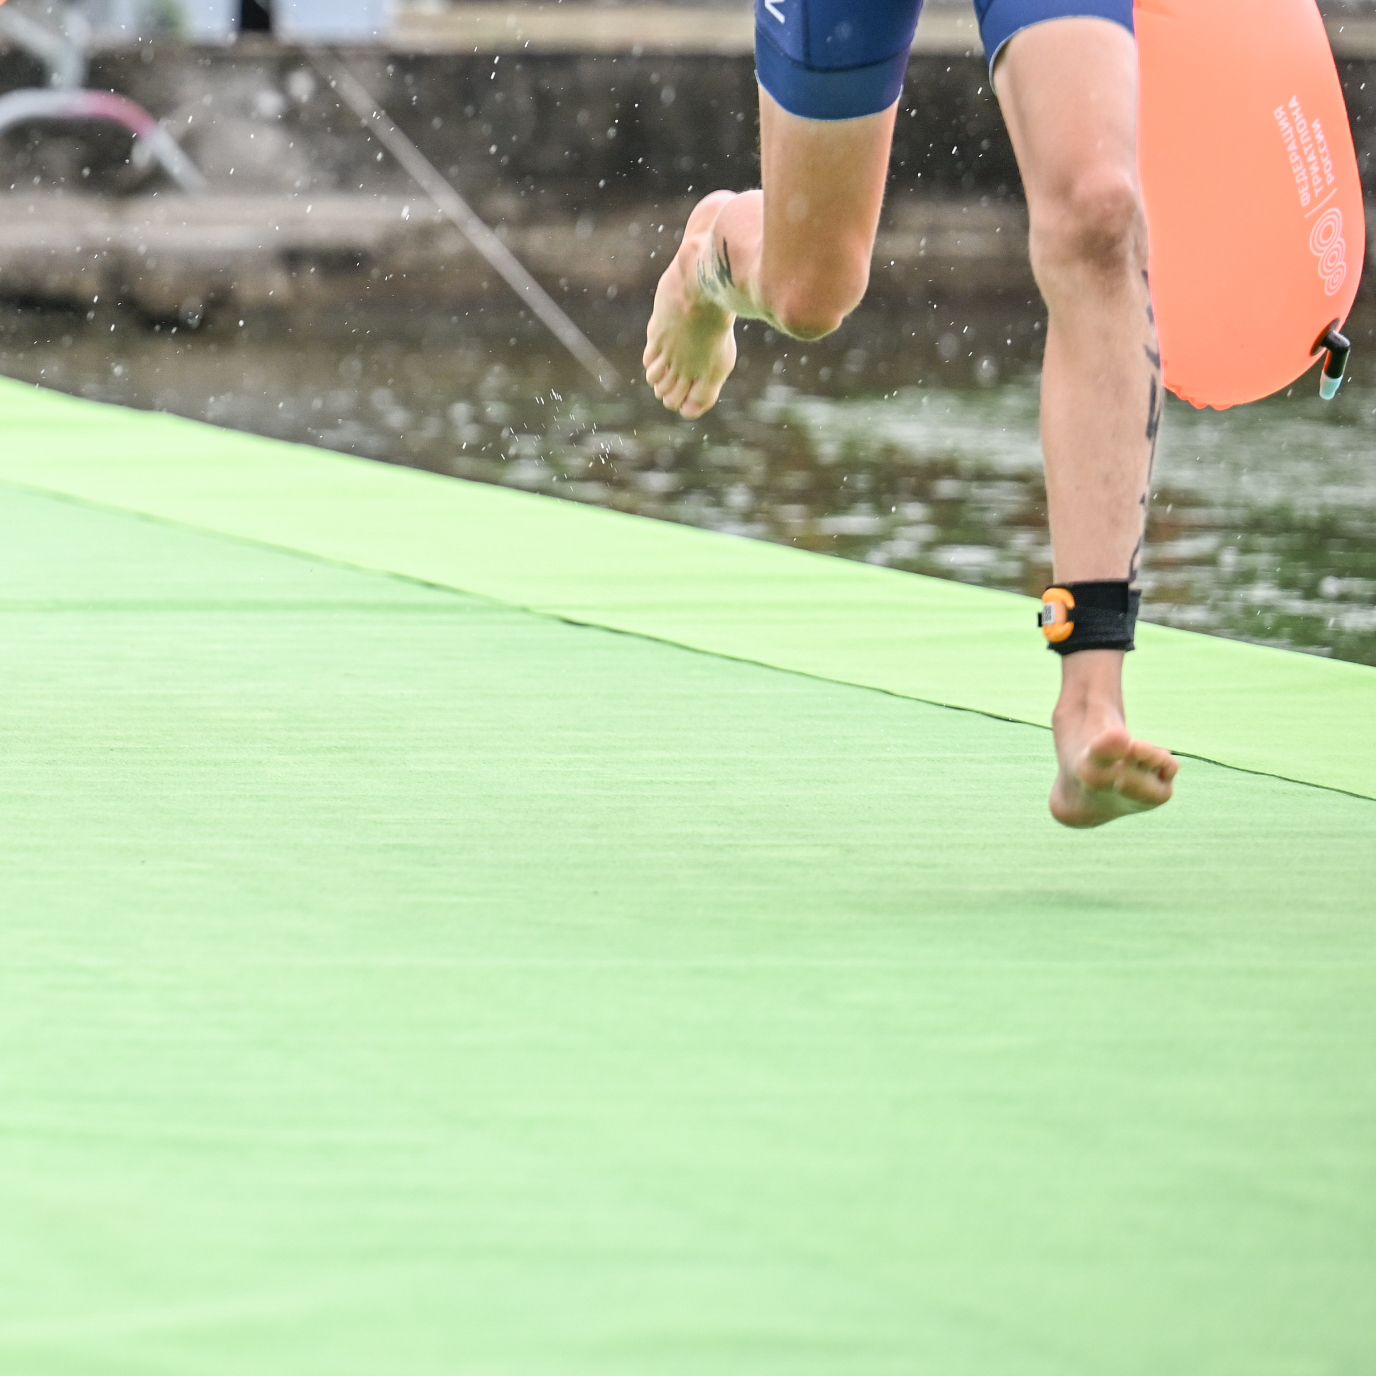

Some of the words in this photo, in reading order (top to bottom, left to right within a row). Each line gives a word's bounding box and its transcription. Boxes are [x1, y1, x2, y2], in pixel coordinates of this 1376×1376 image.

[1273, 105, 1311, 207] ФЕДЕРАЦИЯ
[1288, 94, 1324, 198] ТРИАТЛОНА
[1312, 118, 1335, 185] РОССИИ
